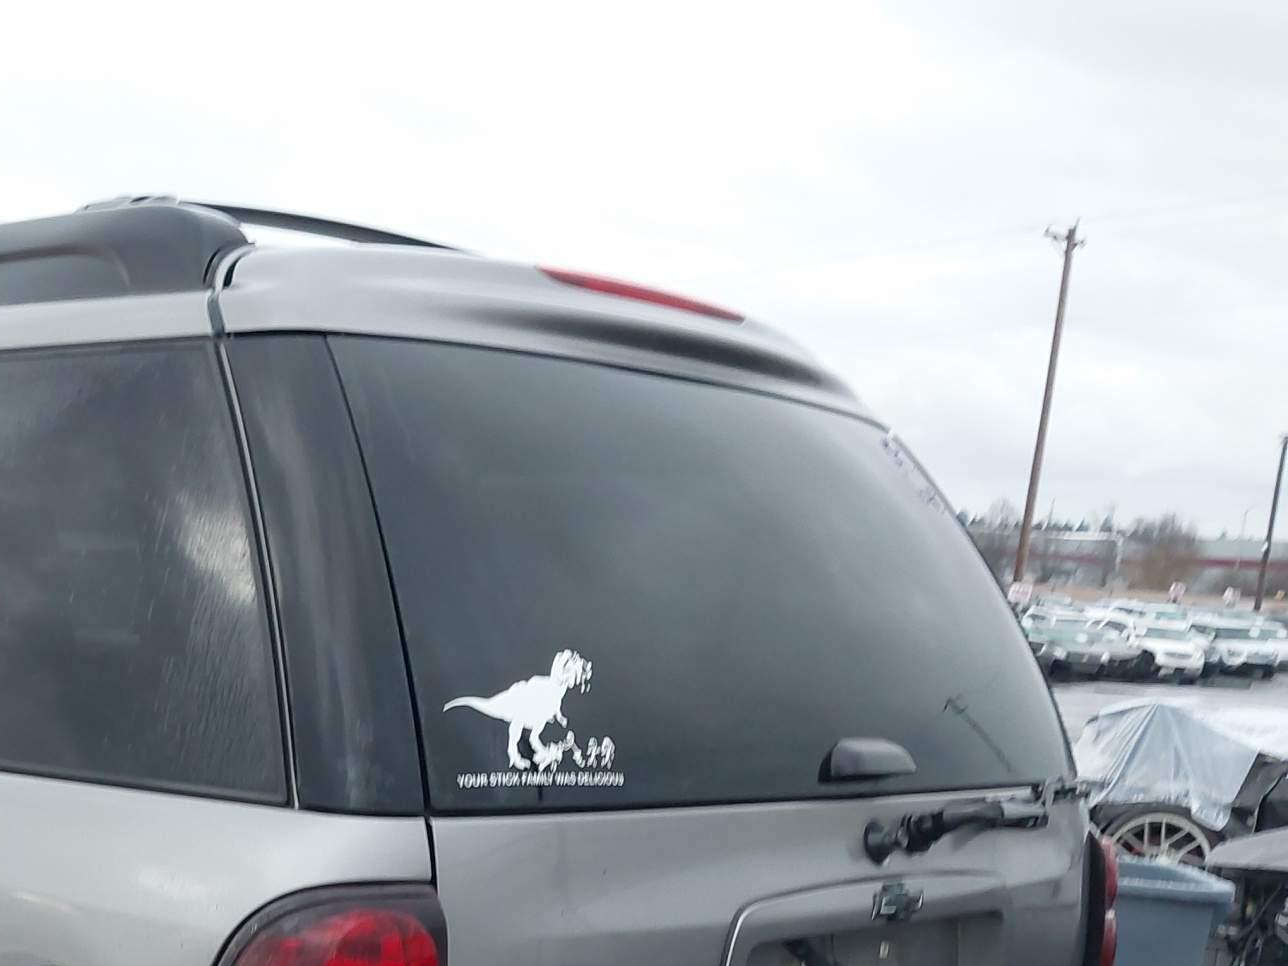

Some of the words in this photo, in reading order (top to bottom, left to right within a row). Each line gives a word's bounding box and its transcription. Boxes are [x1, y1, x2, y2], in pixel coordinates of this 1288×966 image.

[457, 773, 488, 789] YOUR
[489, 772, 520, 787] STICK
[521, 771, 554, 786] FAMILY
[555, 771, 577, 786] WAS
[577, 771, 625, 787] DELICIOUS
